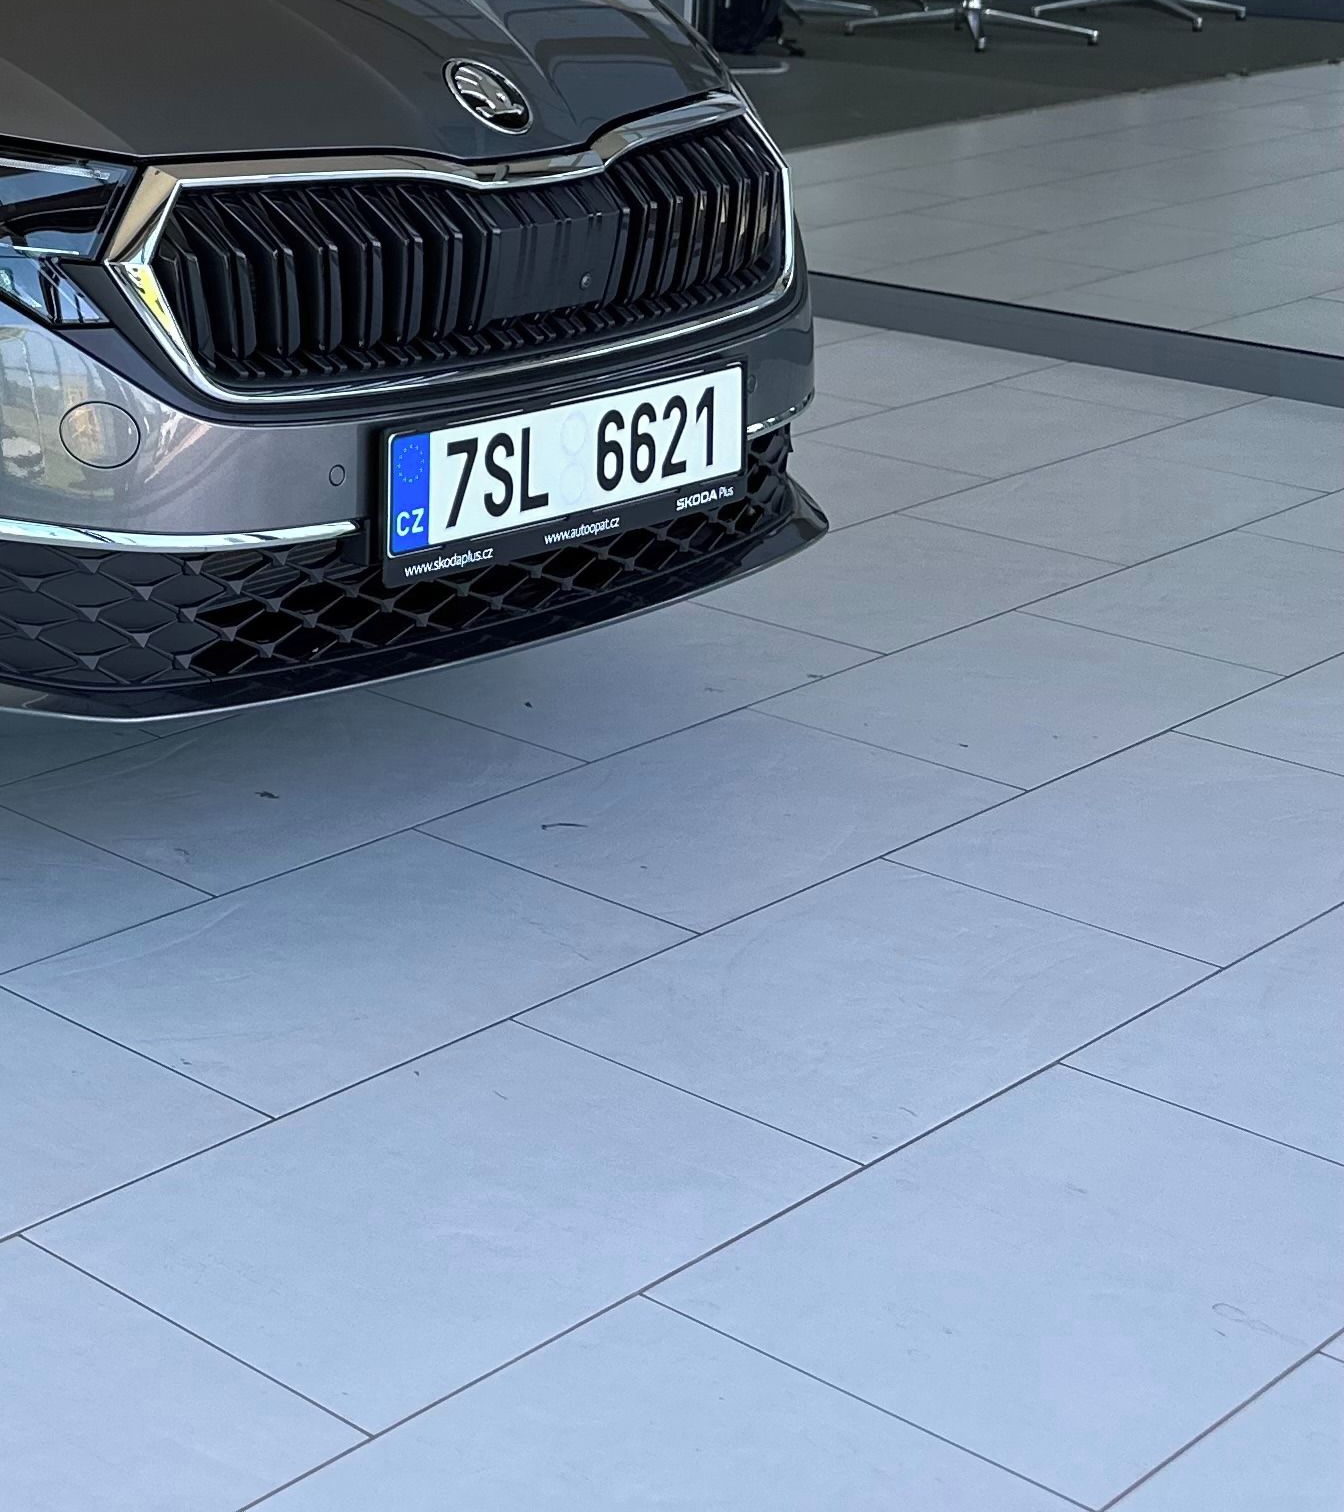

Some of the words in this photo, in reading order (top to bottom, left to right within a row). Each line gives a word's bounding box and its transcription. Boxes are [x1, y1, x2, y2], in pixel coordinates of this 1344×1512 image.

[446, 426, 549, 529] 7SL
[596, 386, 715, 492] 6621
[718, 485, 735, 500] Plus
[395, 506, 425, 538] CZ
[544, 516, 621, 545] www.autoopat.cz
[404, 546, 494, 578] www.skodaplus.cz
